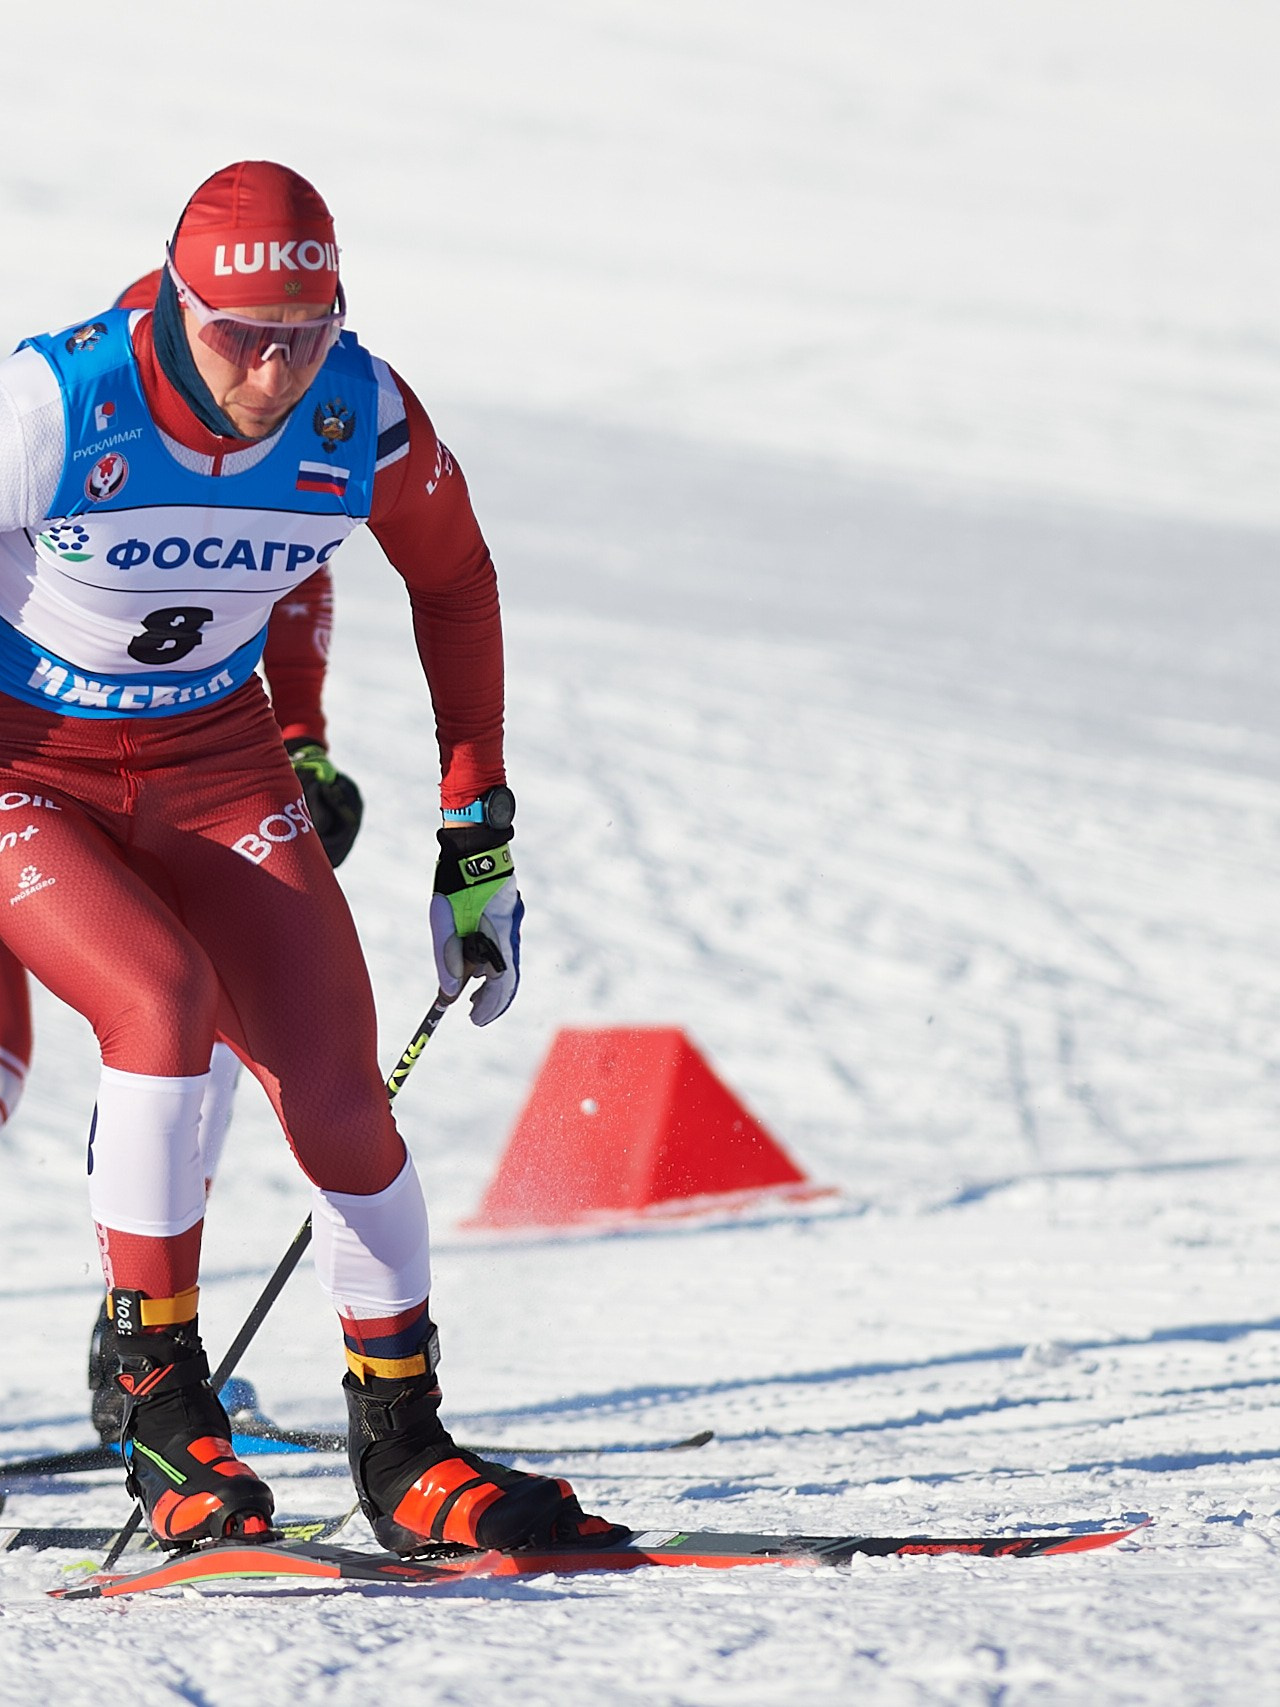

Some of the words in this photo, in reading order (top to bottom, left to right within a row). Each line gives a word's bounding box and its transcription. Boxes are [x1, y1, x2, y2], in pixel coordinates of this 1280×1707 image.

[214, 240, 338, 276] LUKOIL
[73, 428, 144, 462] РУСКЛИМАТ
[127, 606, 214, 665] 8
[10, 877, 56, 906] PHOSAGRO
